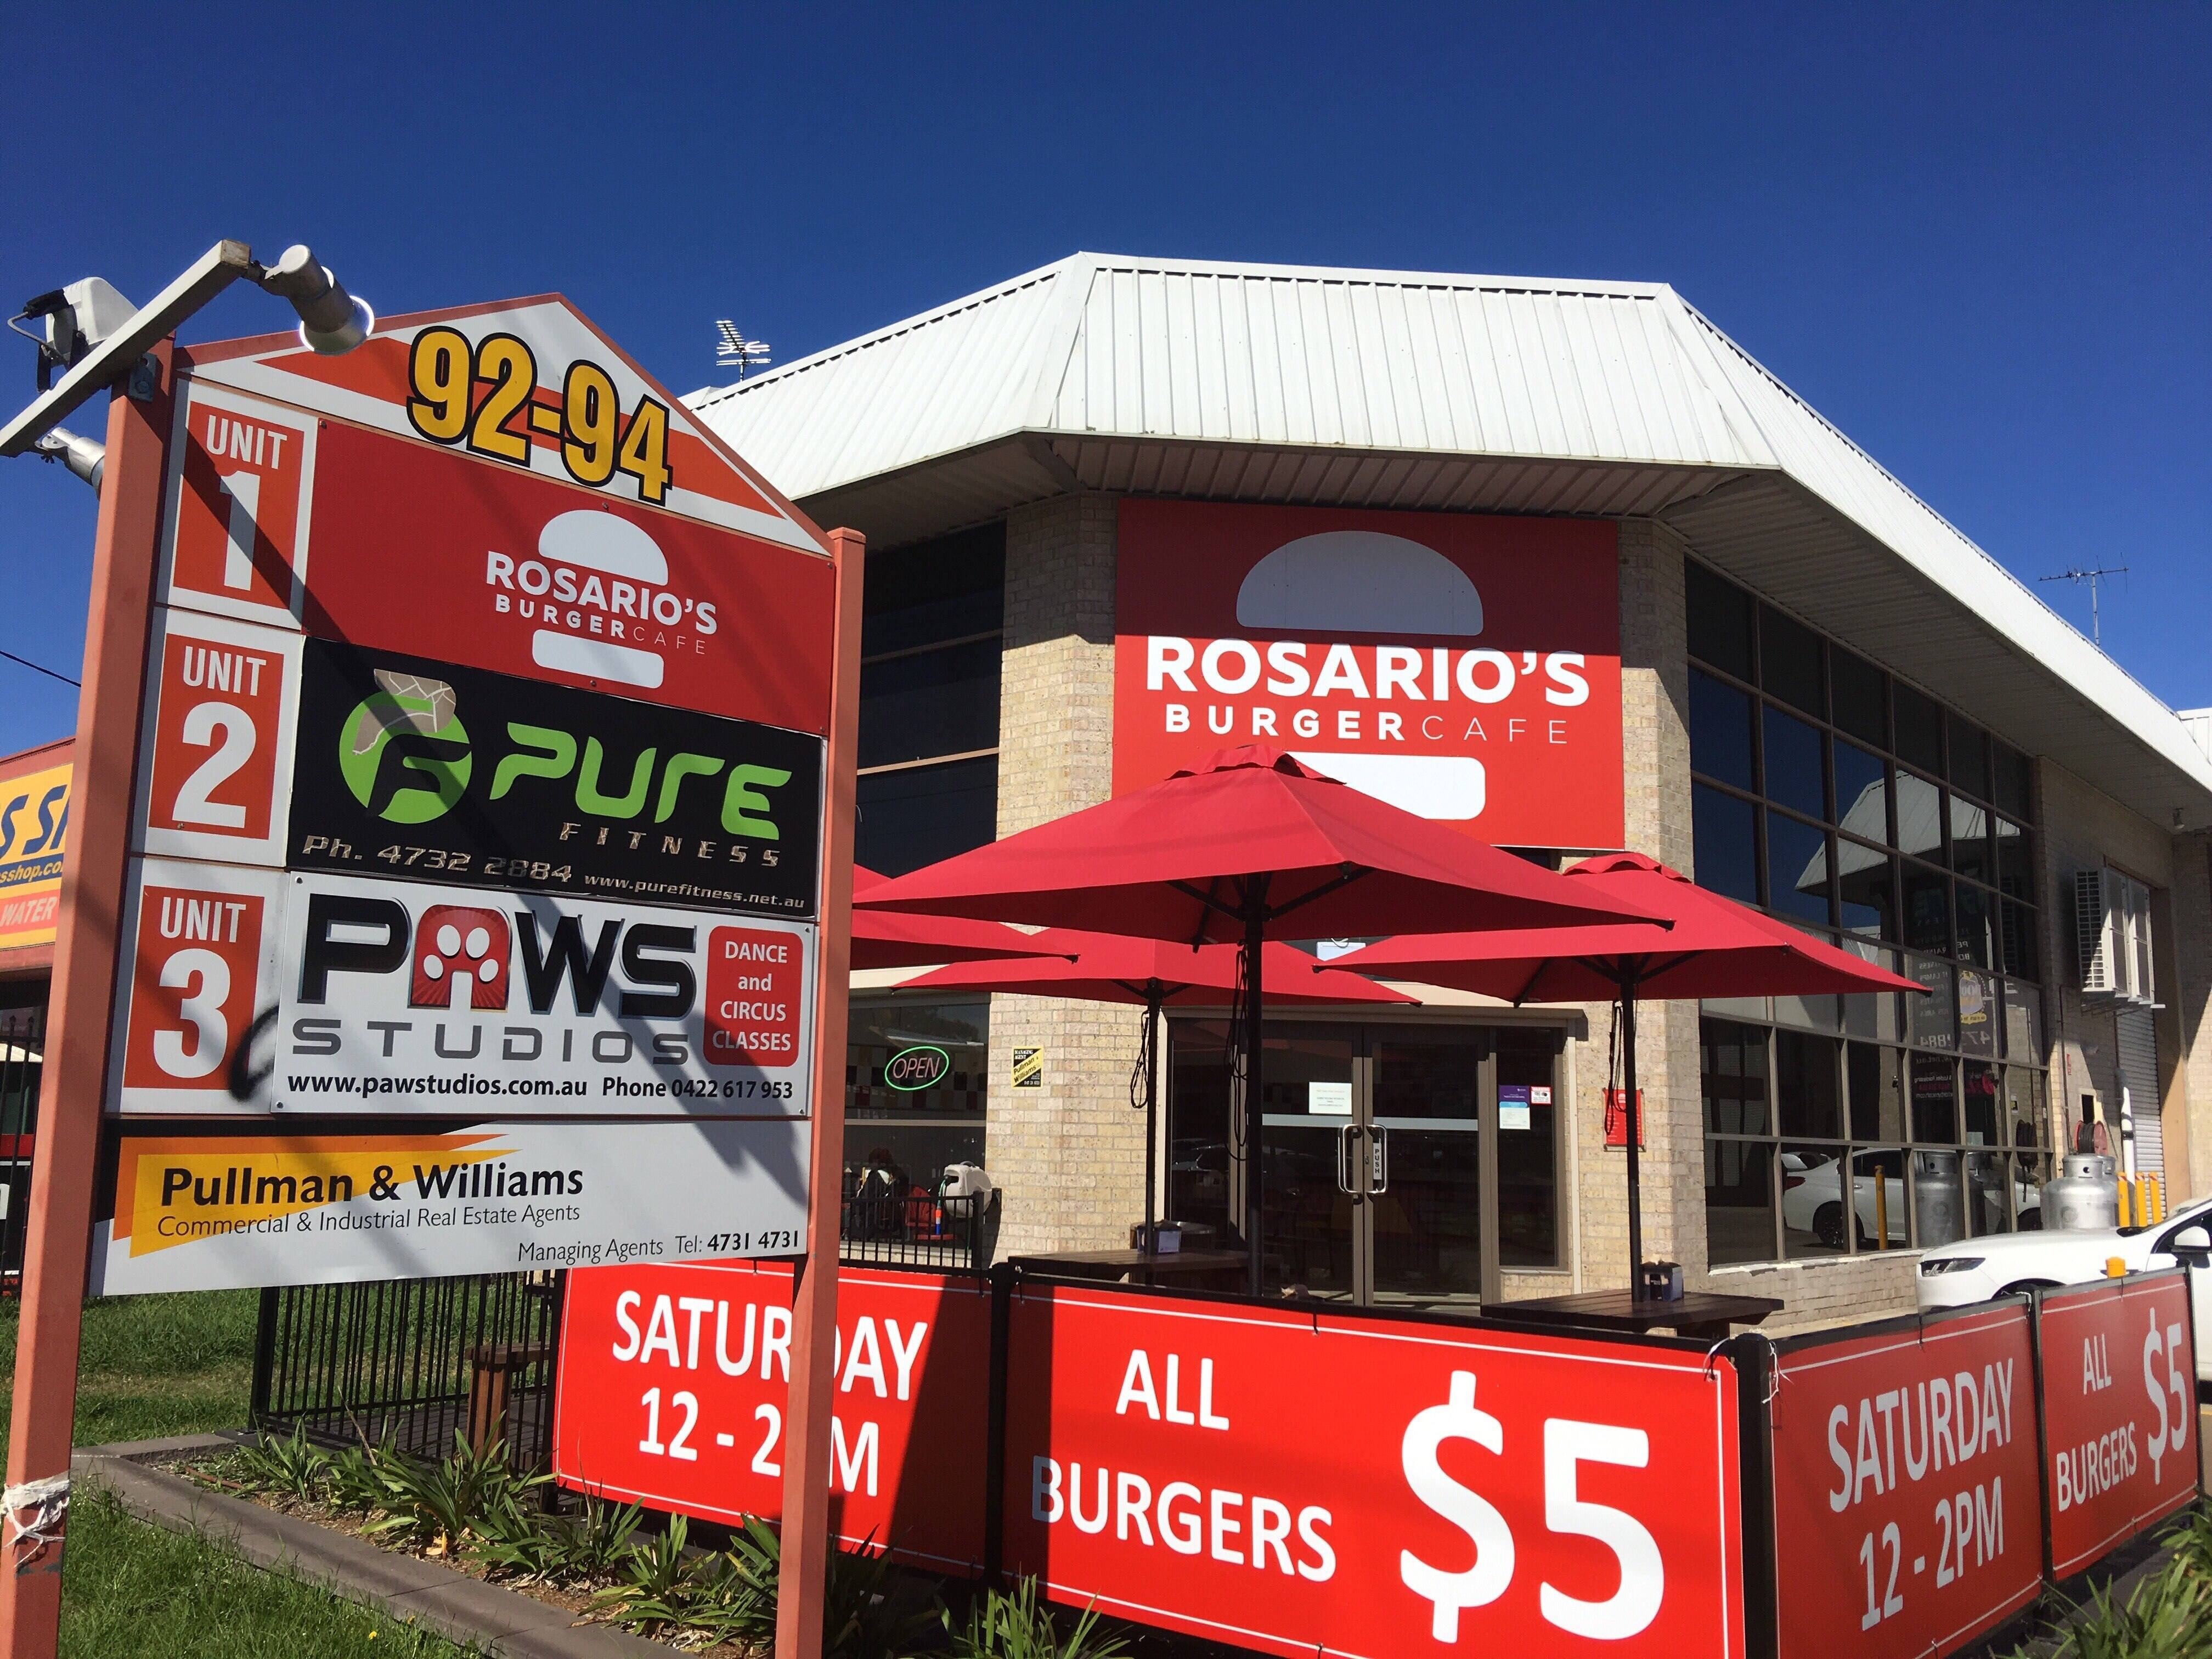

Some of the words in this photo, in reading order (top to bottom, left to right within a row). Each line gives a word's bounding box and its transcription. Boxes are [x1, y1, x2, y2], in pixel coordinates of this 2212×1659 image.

[407, 325, 673, 507] 92-94
[206, 415, 287, 470] UNIT
[220, 470, 260, 591] 1
[486, 550, 718, 635] ROSARIO'S
[183, 646, 266, 696] UNIT
[1147, 635, 1590, 707] ROSARIO'S
[172, 702, 256, 828] 2
[489, 722, 792, 840] PURE
[302, 836, 362, 860] Ph.
[377, 845, 471, 871] 4732
[484, 856, 572, 883] 2884
[559, 822, 780, 867] FITNESS
[0, 861, 62, 883] sshop.co
[585, 874, 805, 909] www.purefitness.net.au
[0, 897, 57, 926] WATER
[160, 897, 246, 943] UNIT
[297, 893, 698, 1021] PAWS
[725, 941, 788, 963] DANCE
[738, 973, 772, 992] and
[153, 948, 230, 1079] 3
[720, 1001, 786, 1022] CIRCUS
[292, 1018, 689, 1065] STUDIOS
[712, 1030, 791, 1051] CLASSES
[1014, 1057, 1035, 1075] Pullman
[287, 1073, 588, 1098] www.pawstudios.com.au
[603, 1076, 667, 1098] Phone
[672, 1079, 718, 1098] 0422
[723, 1080, 756, 1098] 617
[761, 1080, 793, 1099] 953
[893, 1057, 940, 1079] OPEN
[1014, 1065, 1036, 1083] Williams
[161, 1167, 353, 1206] Pullman
[369, 1165, 401, 1200] &
[413, 1162, 583, 1199] Williams
[158, 1212, 289, 1237] Commercial
[296, 1212, 312, 1232] &
[320, 1207, 410, 1231] Industrial
[418, 1207, 455, 1227] Real
[463, 1205, 517, 1224] Estate
[521, 1204, 580, 1227] Agents
[518, 1240, 601, 1265] Managing
[606, 1238, 663, 1265] Agents
[675, 1235, 702, 1254] Tel:
[707, 1233, 749, 1251] 4731
[758, 1231, 798, 1248] 4731
[612, 1290, 928, 1401] SATURAY
[2083, 1333, 2112, 1395] ALL
[1116, 1349, 1229, 1431] ALL
[2143, 1307, 2188, 1485] $5
[639, 1387, 698, 1462] 12
[751, 1403, 879, 1497] 2M
[1828, 1357, 2013, 1513] SATURDAY
[2056, 1421, 2137, 1512] BURGERS
[1032, 1455, 1336, 1582] BURGERS
[1400, 1370, 1664, 1644] $5
[1860, 1522, 1904, 1632] 12
[1936, 1476, 2005, 1589] 2PM
